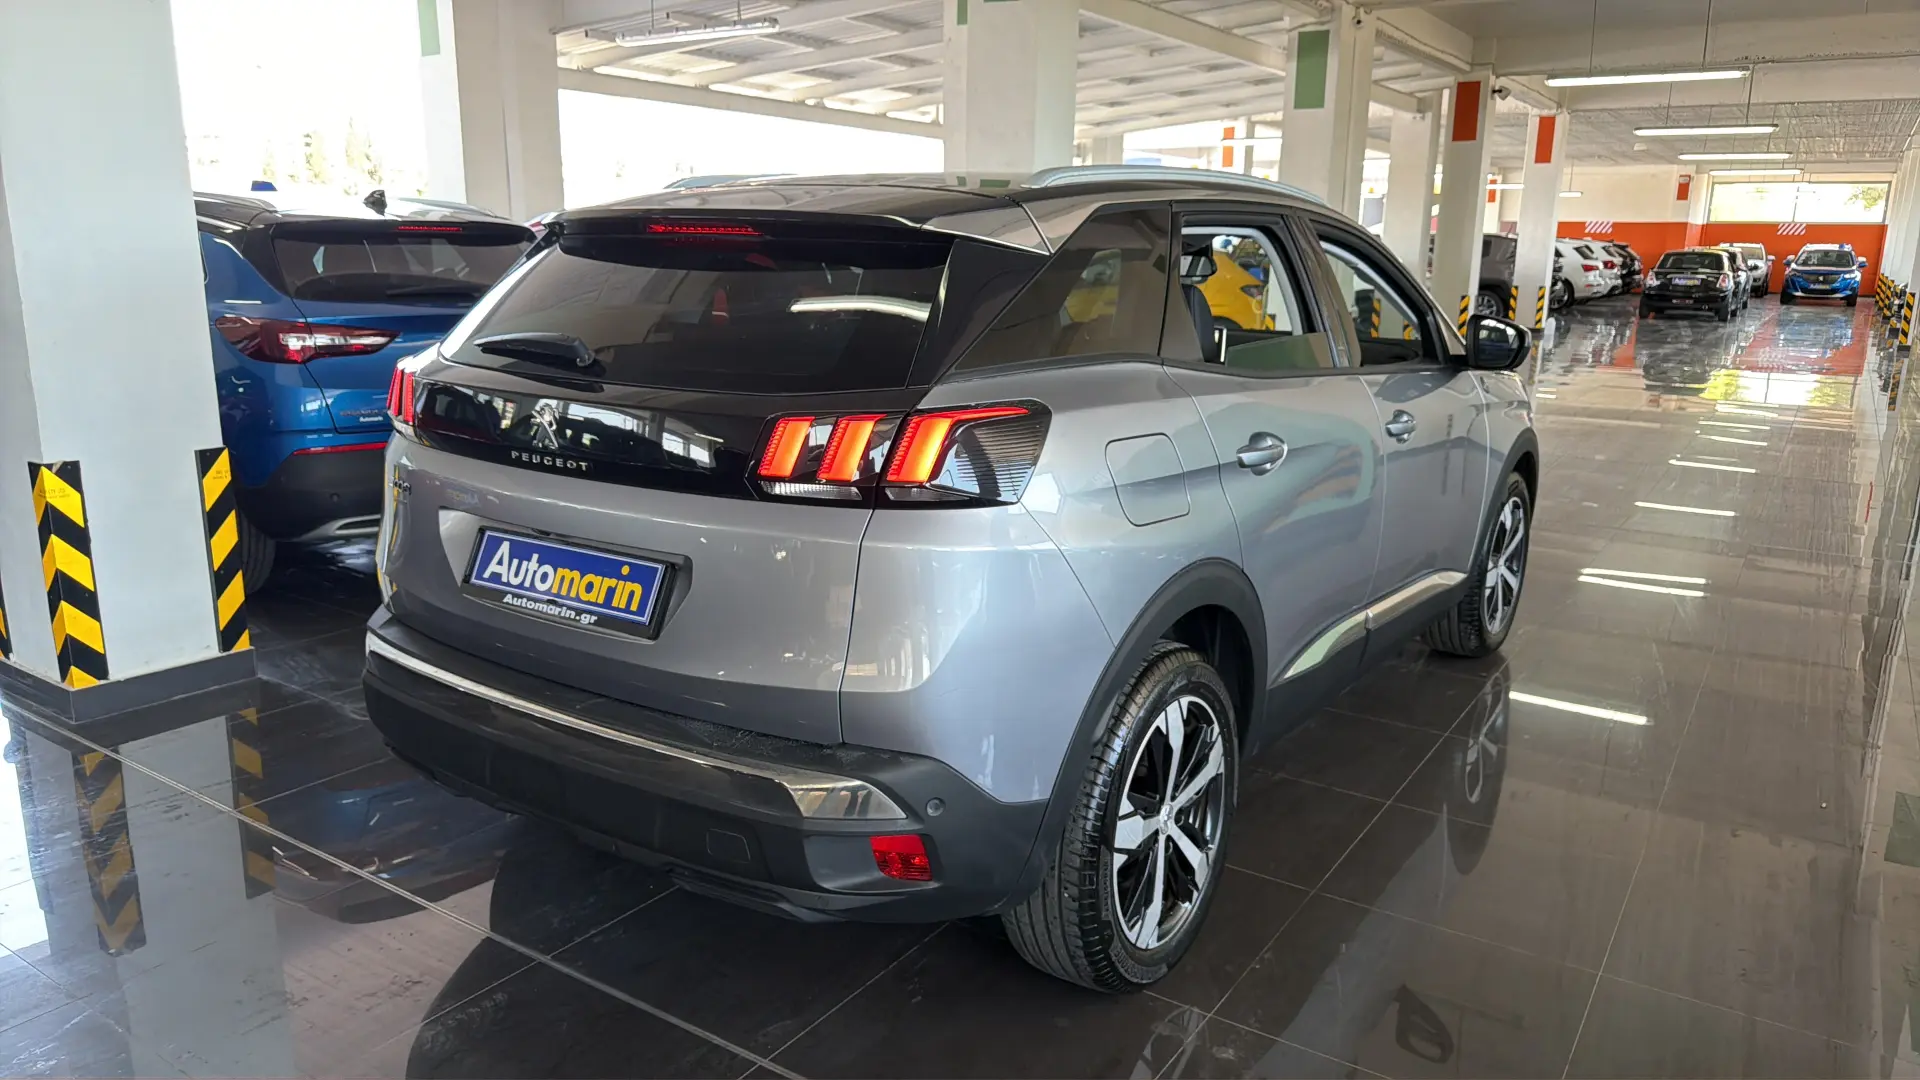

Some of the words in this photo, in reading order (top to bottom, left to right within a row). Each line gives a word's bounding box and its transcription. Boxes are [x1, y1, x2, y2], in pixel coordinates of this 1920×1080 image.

[511, 450, 588, 471] PEUGEOT
[483, 540, 643, 612] Automarin
[502, 593, 598, 624] Automarin.gr
